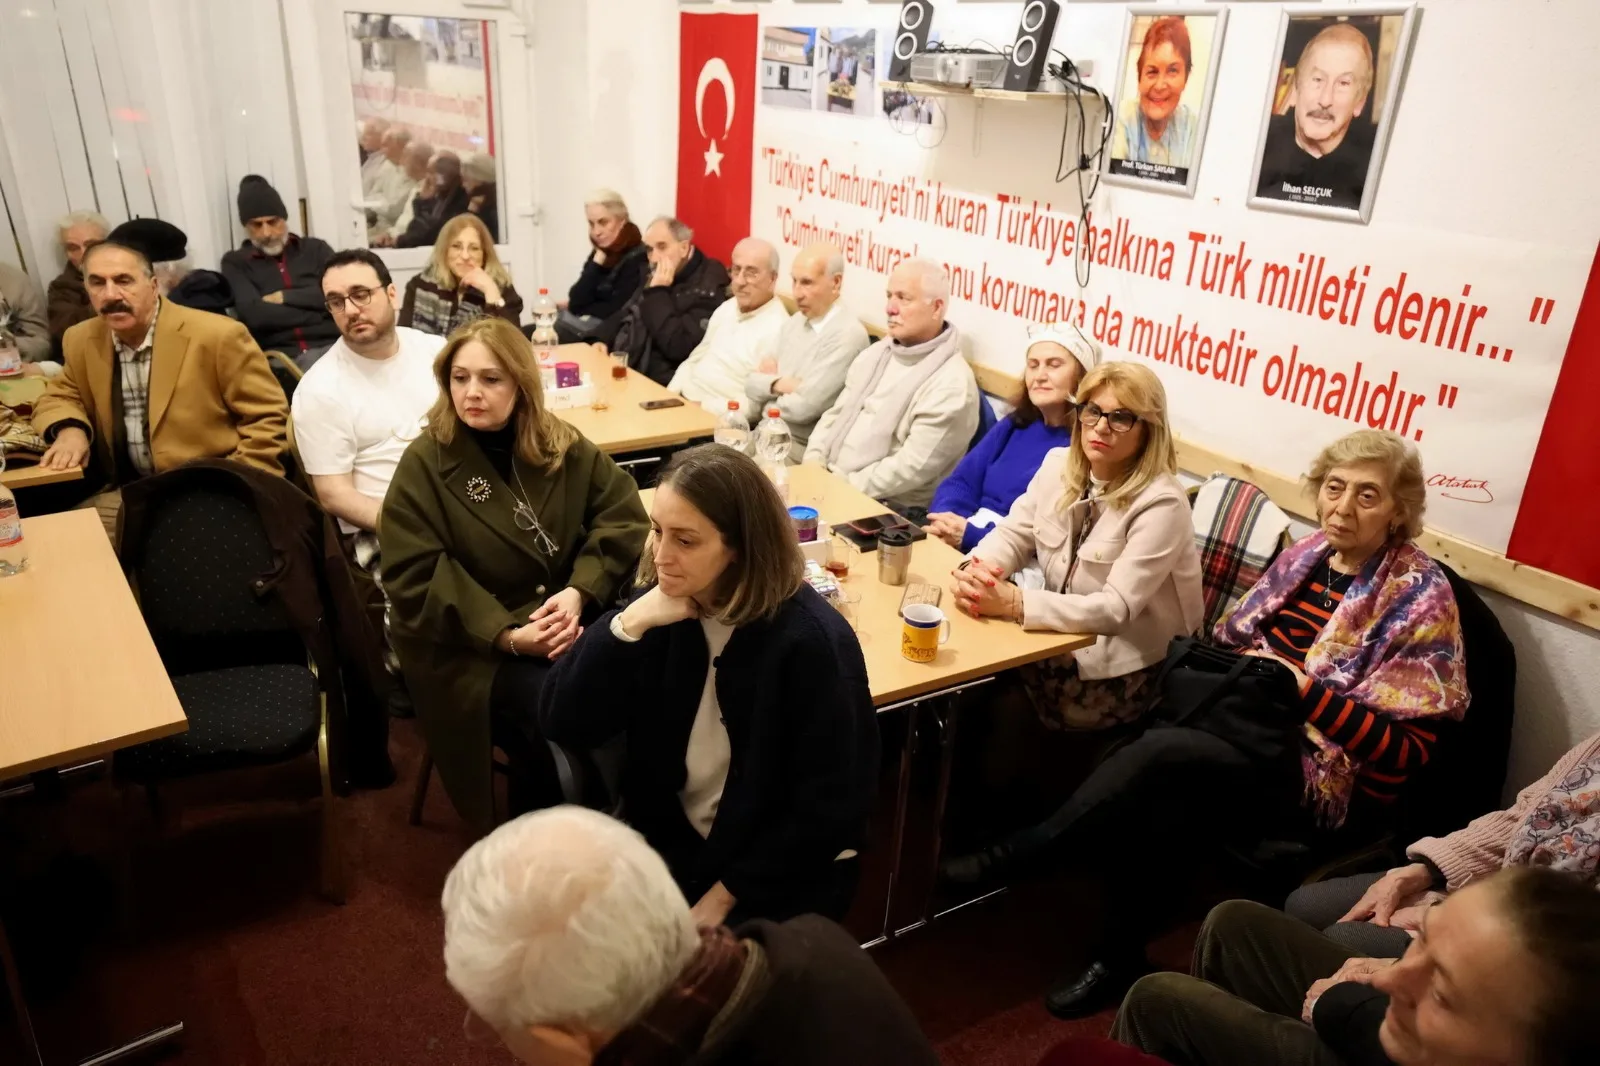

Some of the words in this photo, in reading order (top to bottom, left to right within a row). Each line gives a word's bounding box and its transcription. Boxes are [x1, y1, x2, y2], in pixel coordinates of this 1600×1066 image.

[819, 158, 932, 222] Cumhuriyeti'ni
[934, 182, 987, 235] kuran
[995, 192, 1076, 266] Türkiye
[1080, 211, 1176, 281] halkına
[1185, 230, 1252, 301] Türk
[1256, 251, 1371, 328] milleti
[1302, 185, 1333, 198] SELÇUK
[942, 262, 975, 301] nu
[1092, 295, 1124, 347] da
[1127, 313, 1259, 388] muktedir
